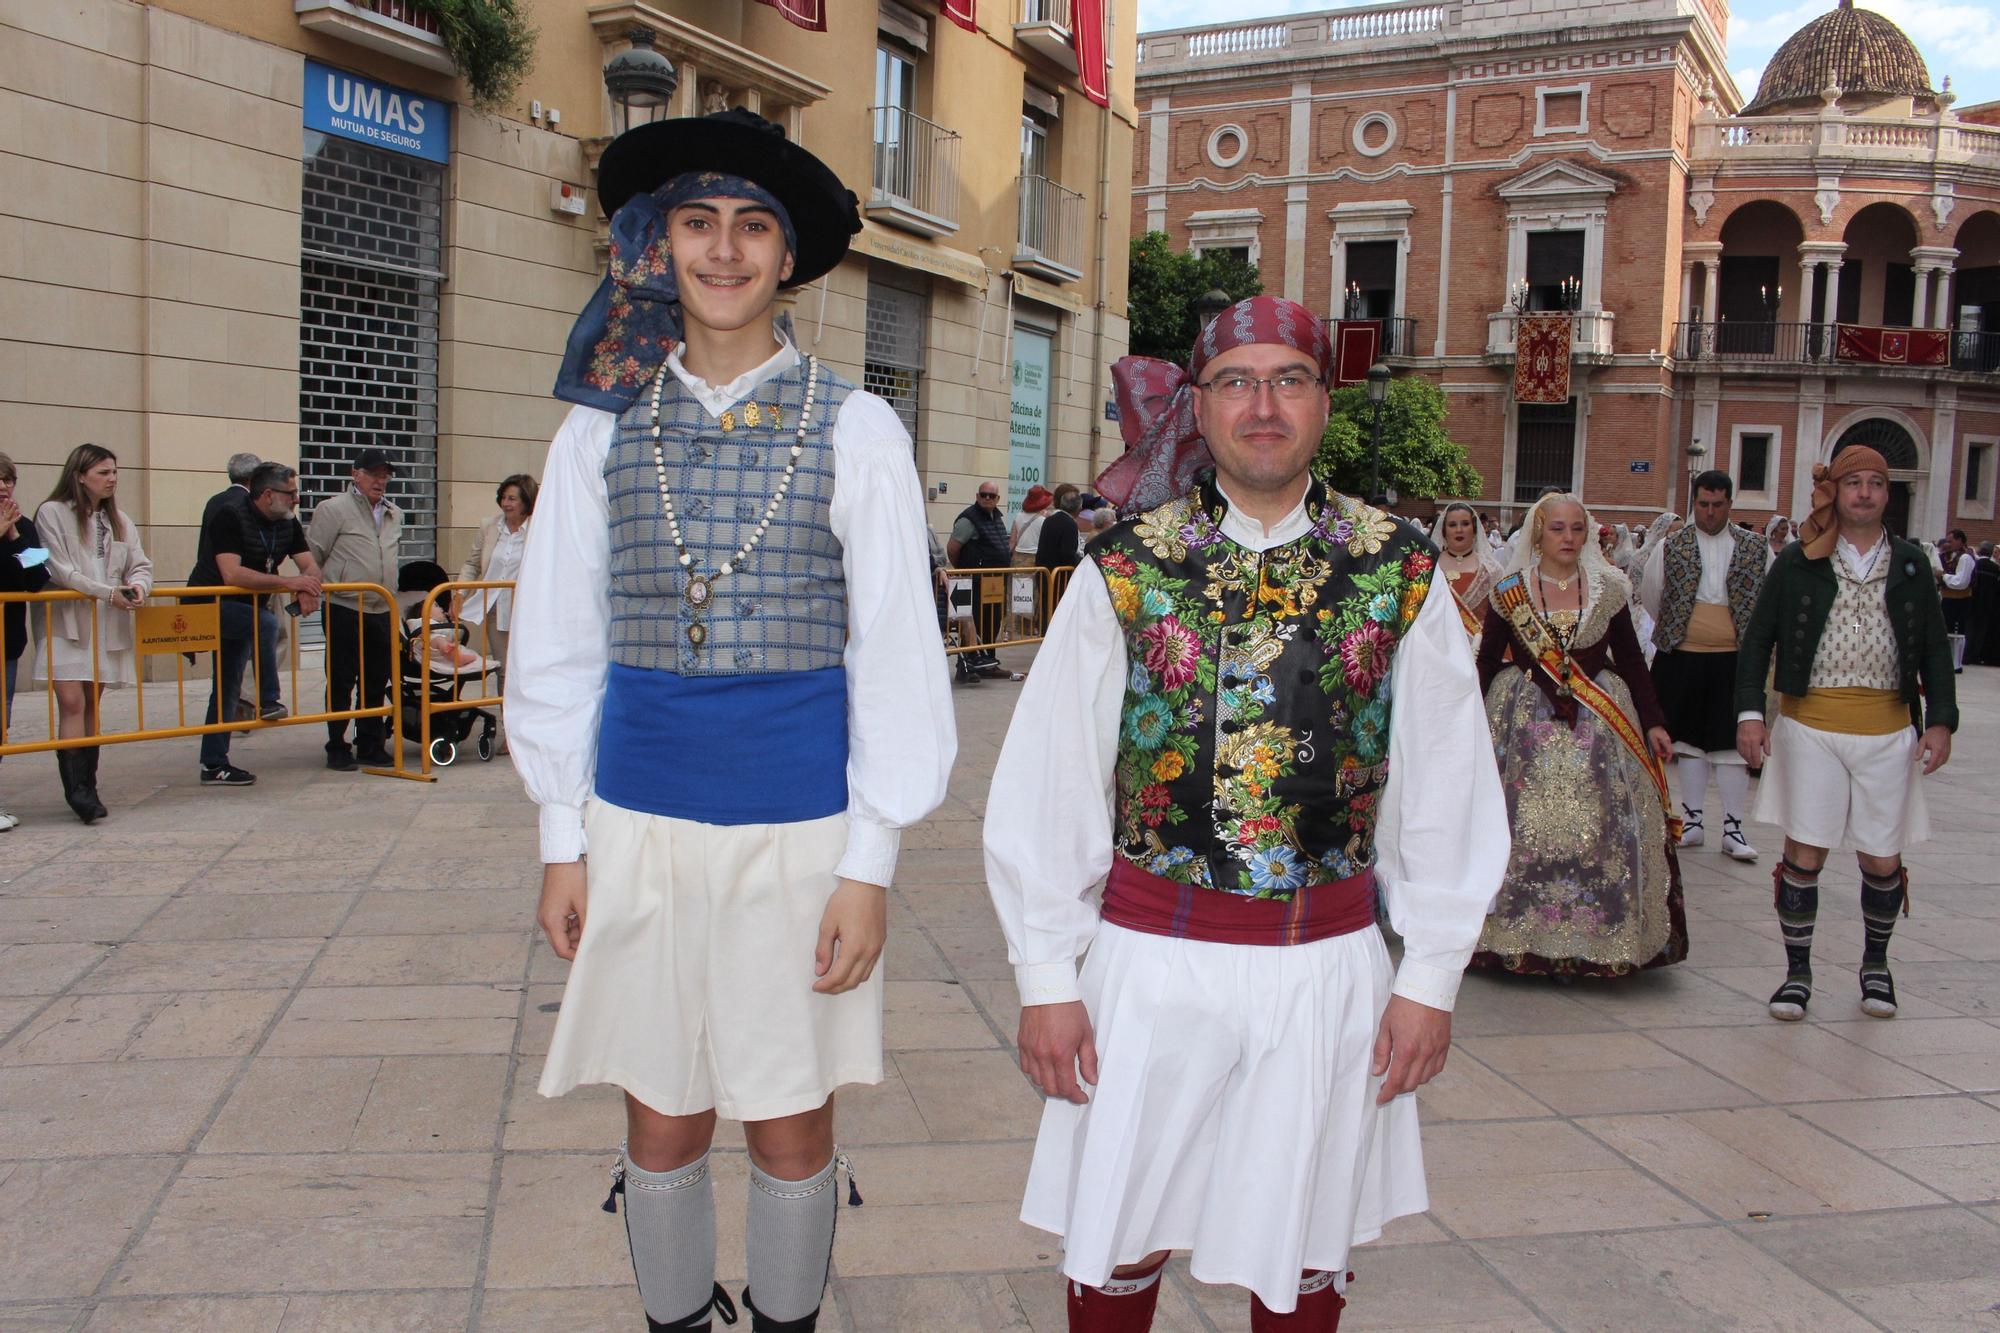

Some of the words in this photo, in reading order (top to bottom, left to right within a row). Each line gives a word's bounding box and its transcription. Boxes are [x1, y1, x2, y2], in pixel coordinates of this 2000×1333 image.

[327, 73, 425, 135] UMAS
[331, 116, 366, 136] MUTUA
[367, 127, 380, 140] DE
[381, 130, 422, 151] SEGUROS
[1010, 401, 1033, 417] Oficina
[1034, 404, 1041, 418] de
[1009, 419, 1041, 437] Atención
[1021, 466, 1039, 482] 100
[142, 636, 180, 645] AJUNTAMENT
